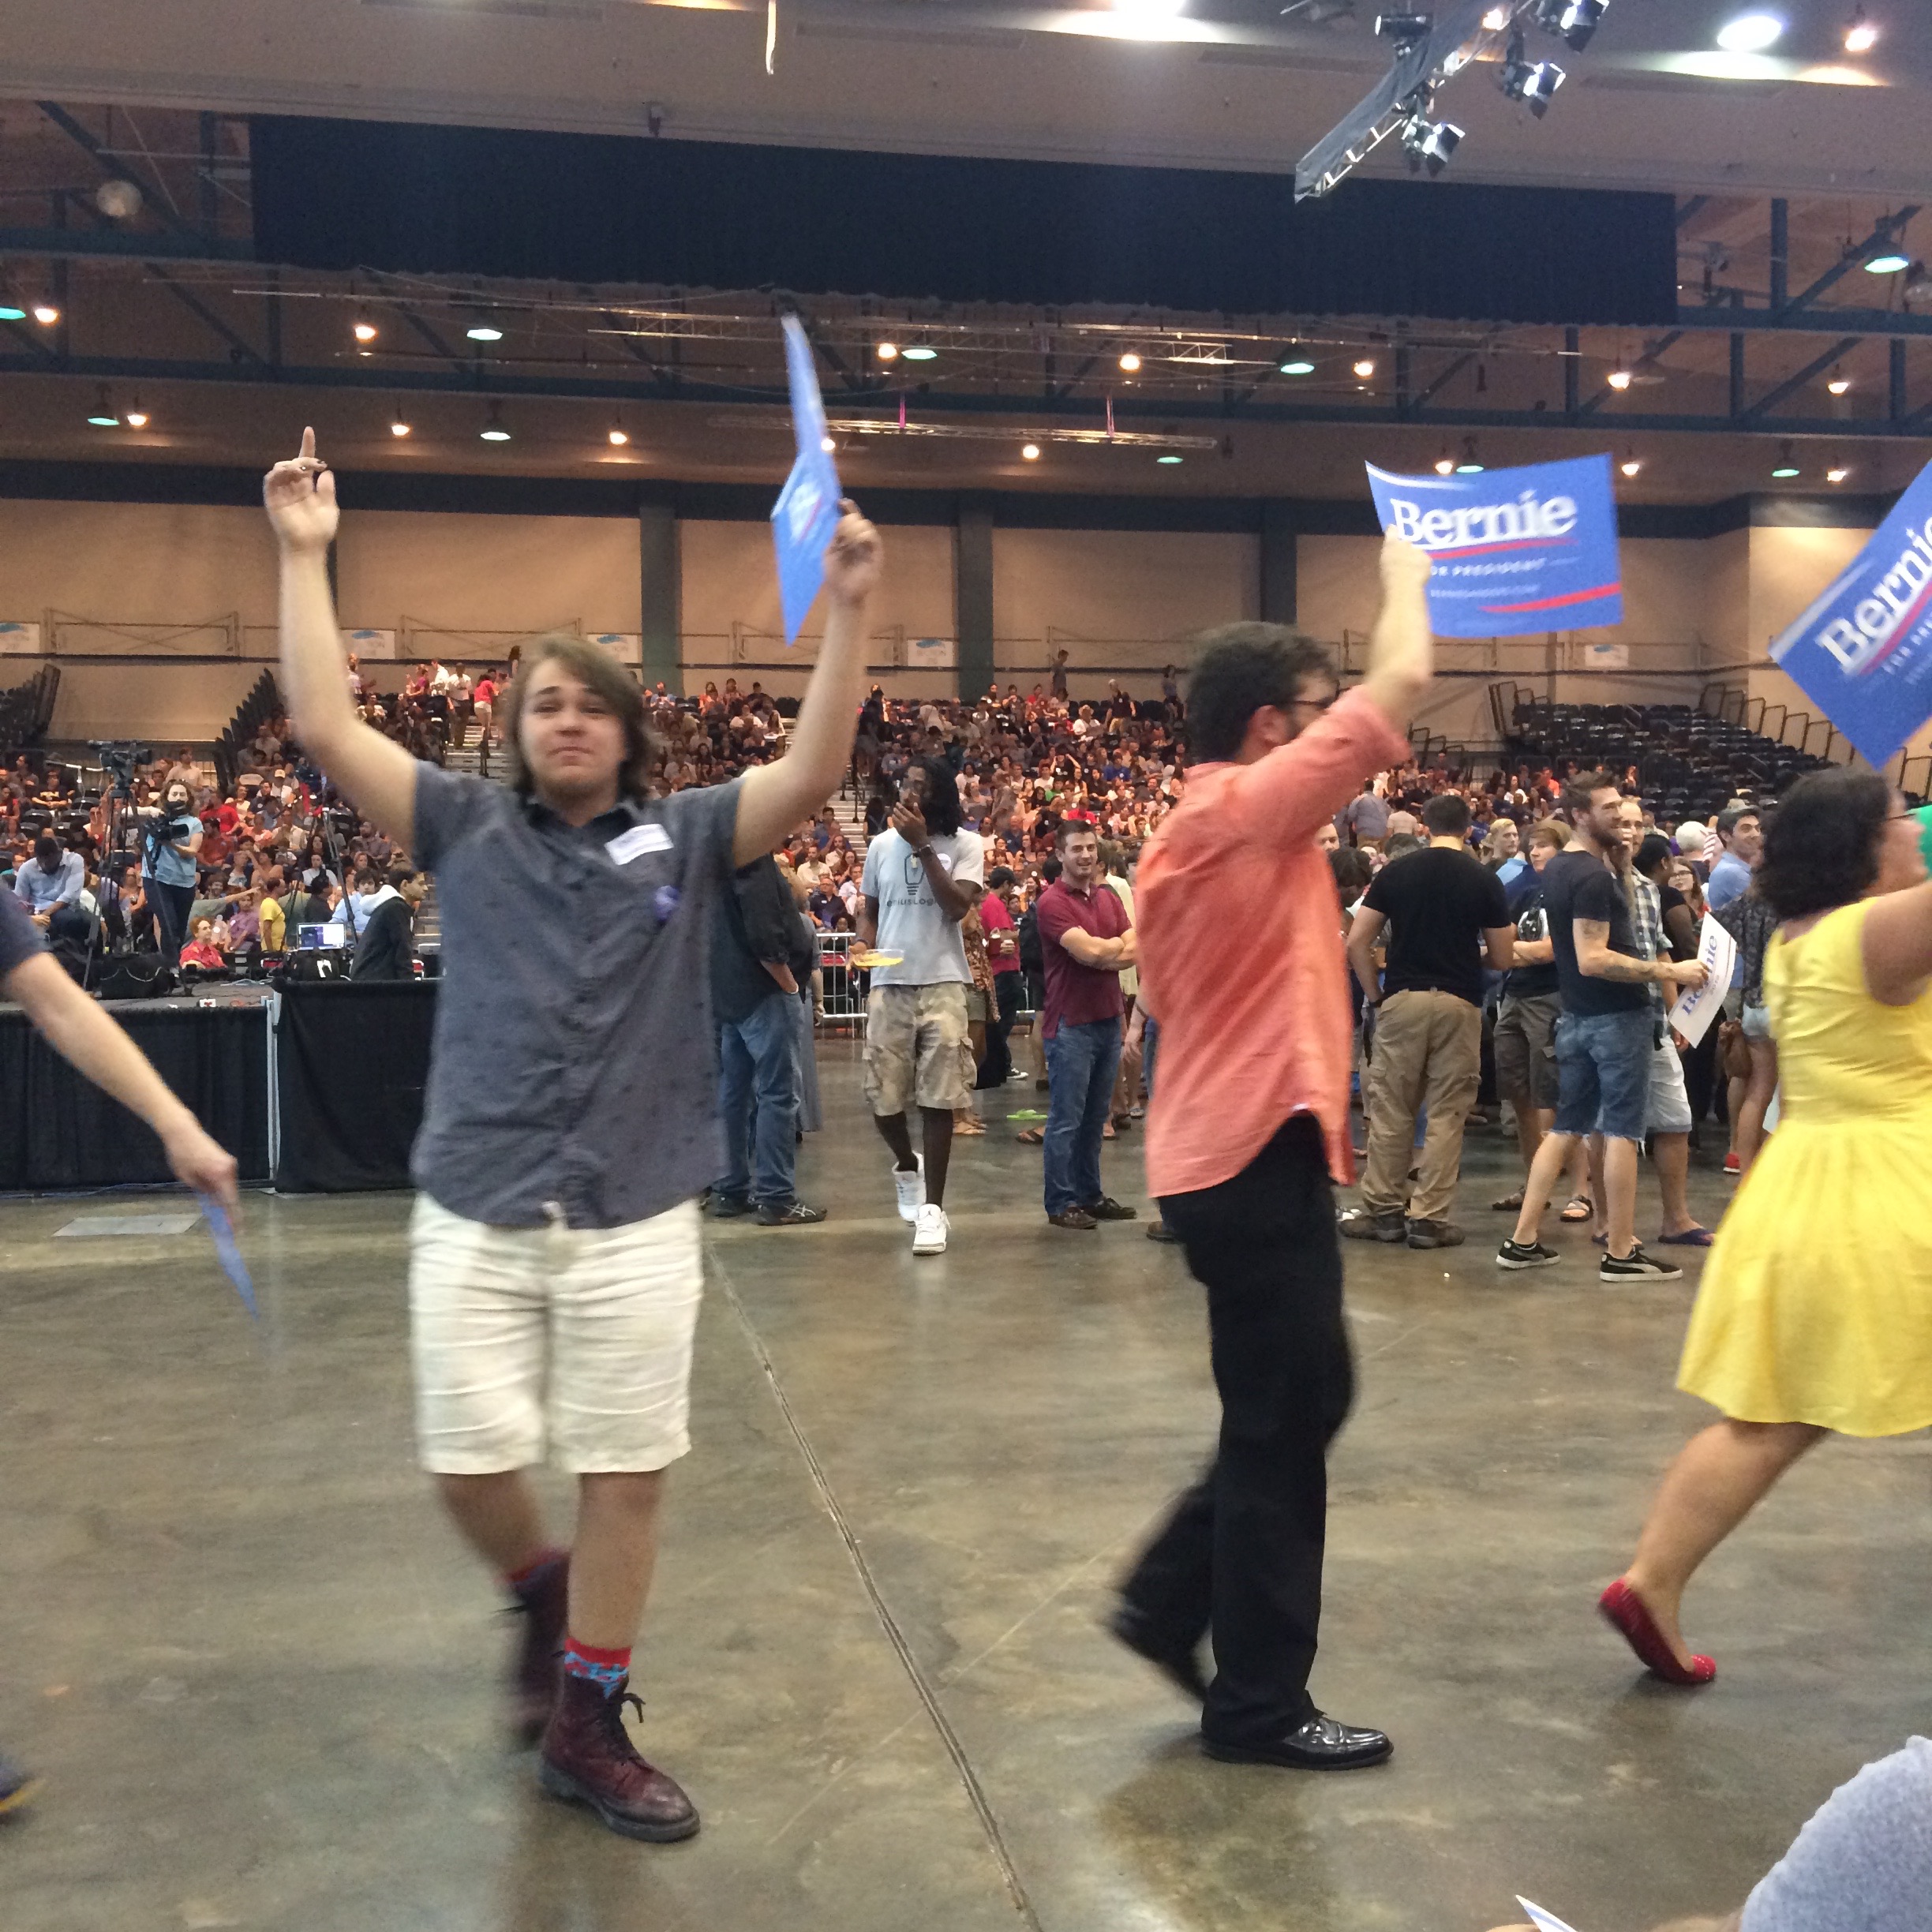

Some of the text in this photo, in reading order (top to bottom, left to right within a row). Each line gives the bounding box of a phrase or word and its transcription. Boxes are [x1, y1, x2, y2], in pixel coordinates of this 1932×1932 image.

[1390, 489, 1578, 545] Bernie
[1814, 517, 1932, 676] Berni
[1682, 935, 1717, 1015] Benie
